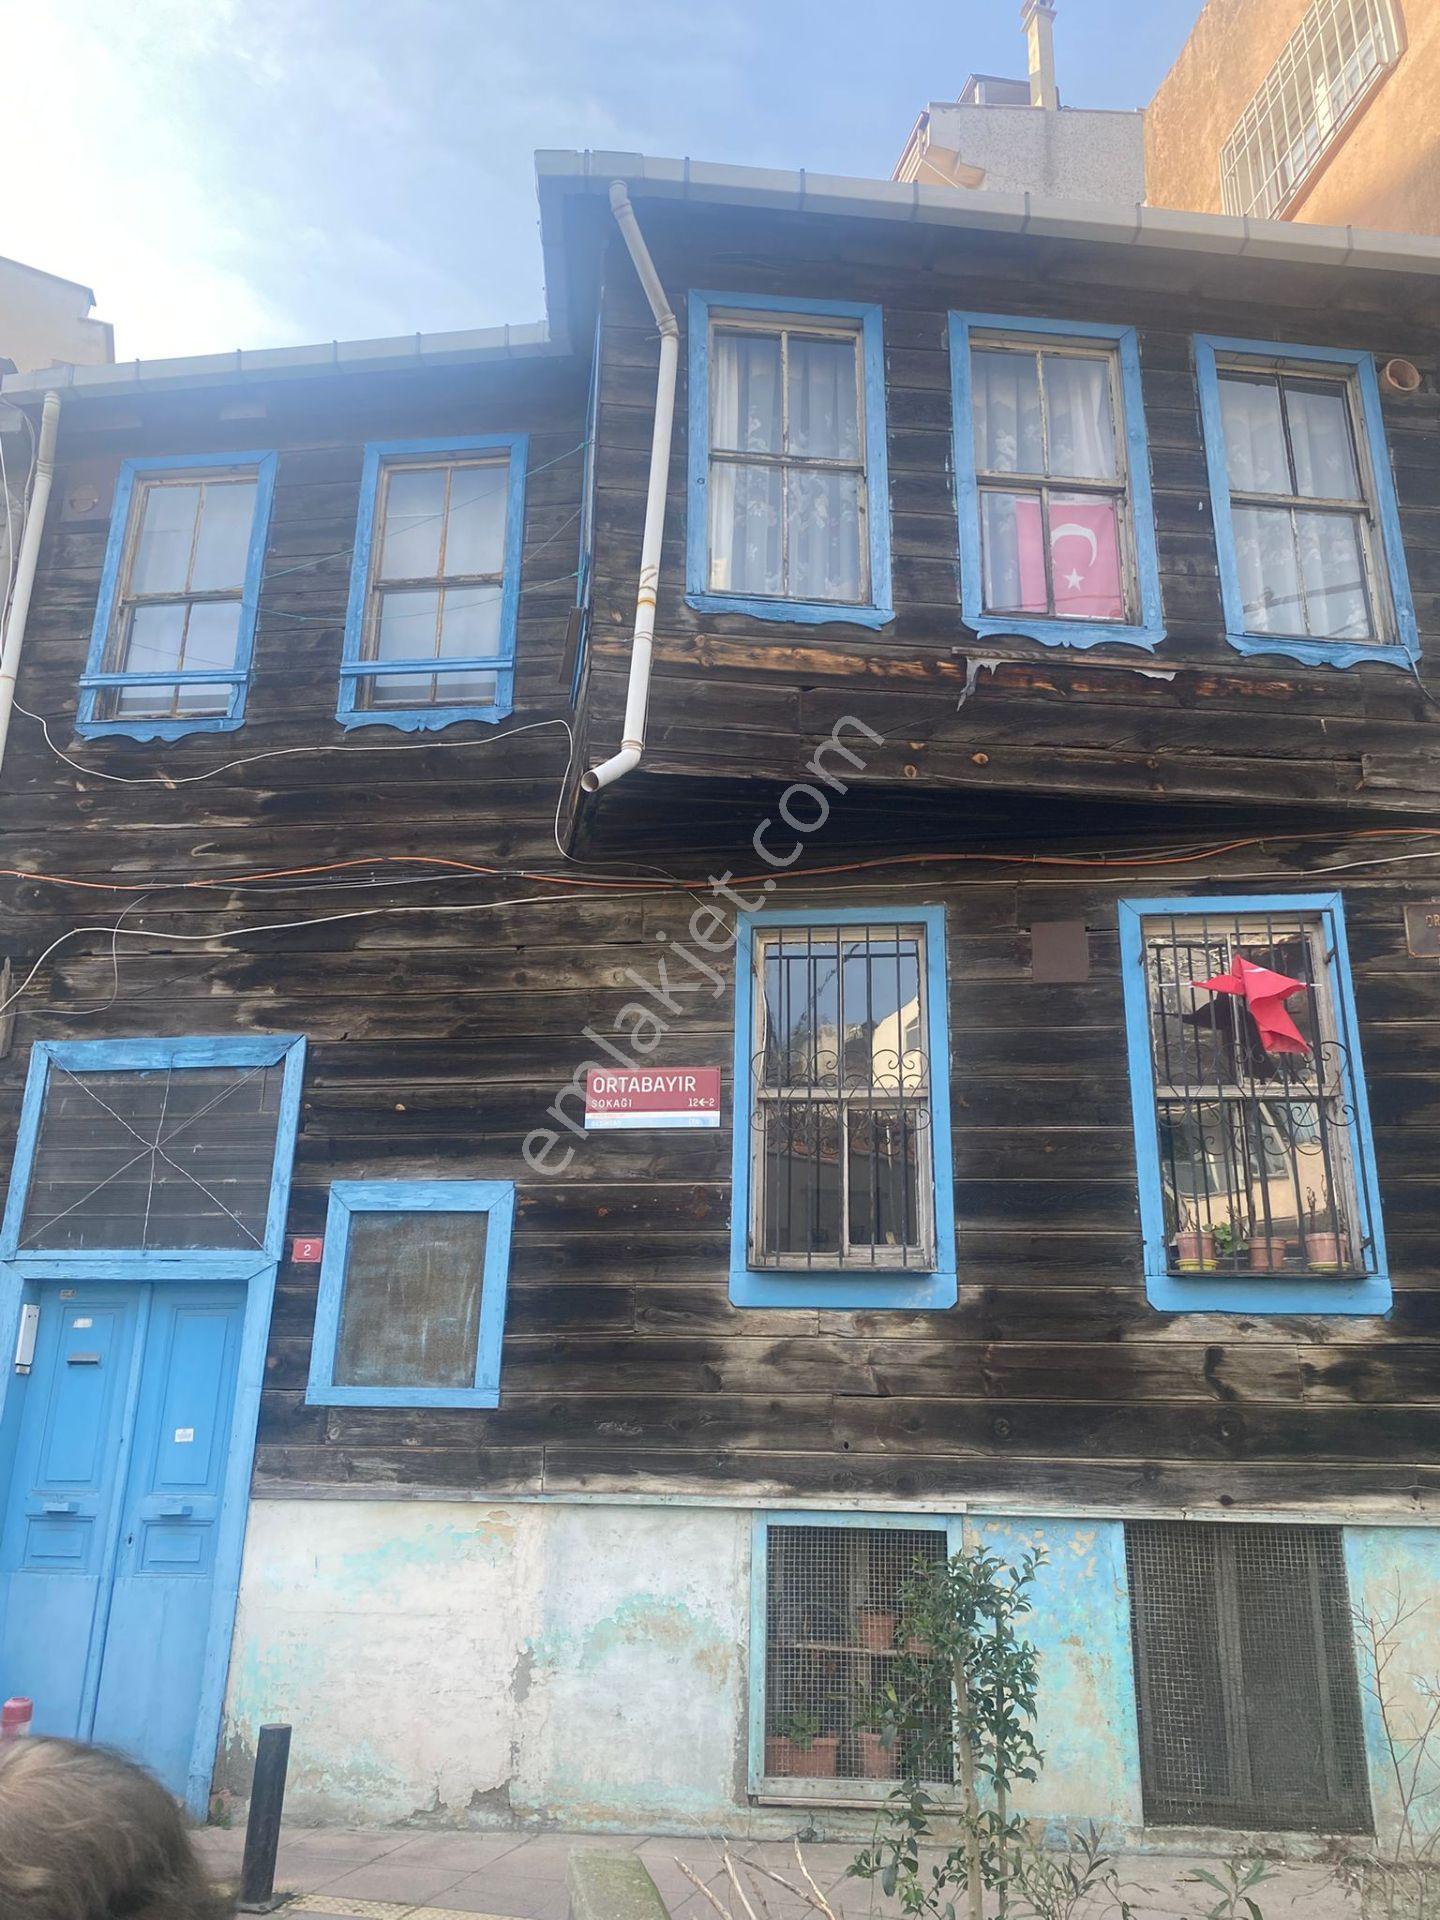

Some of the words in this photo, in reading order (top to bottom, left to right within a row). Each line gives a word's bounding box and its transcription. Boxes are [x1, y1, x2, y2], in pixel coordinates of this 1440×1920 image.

[592, 1075, 697, 1094] ORTABAYIR
[591, 1097, 633, 1109] SOKAĞI
[303, 1243, 312, 1257] 2
